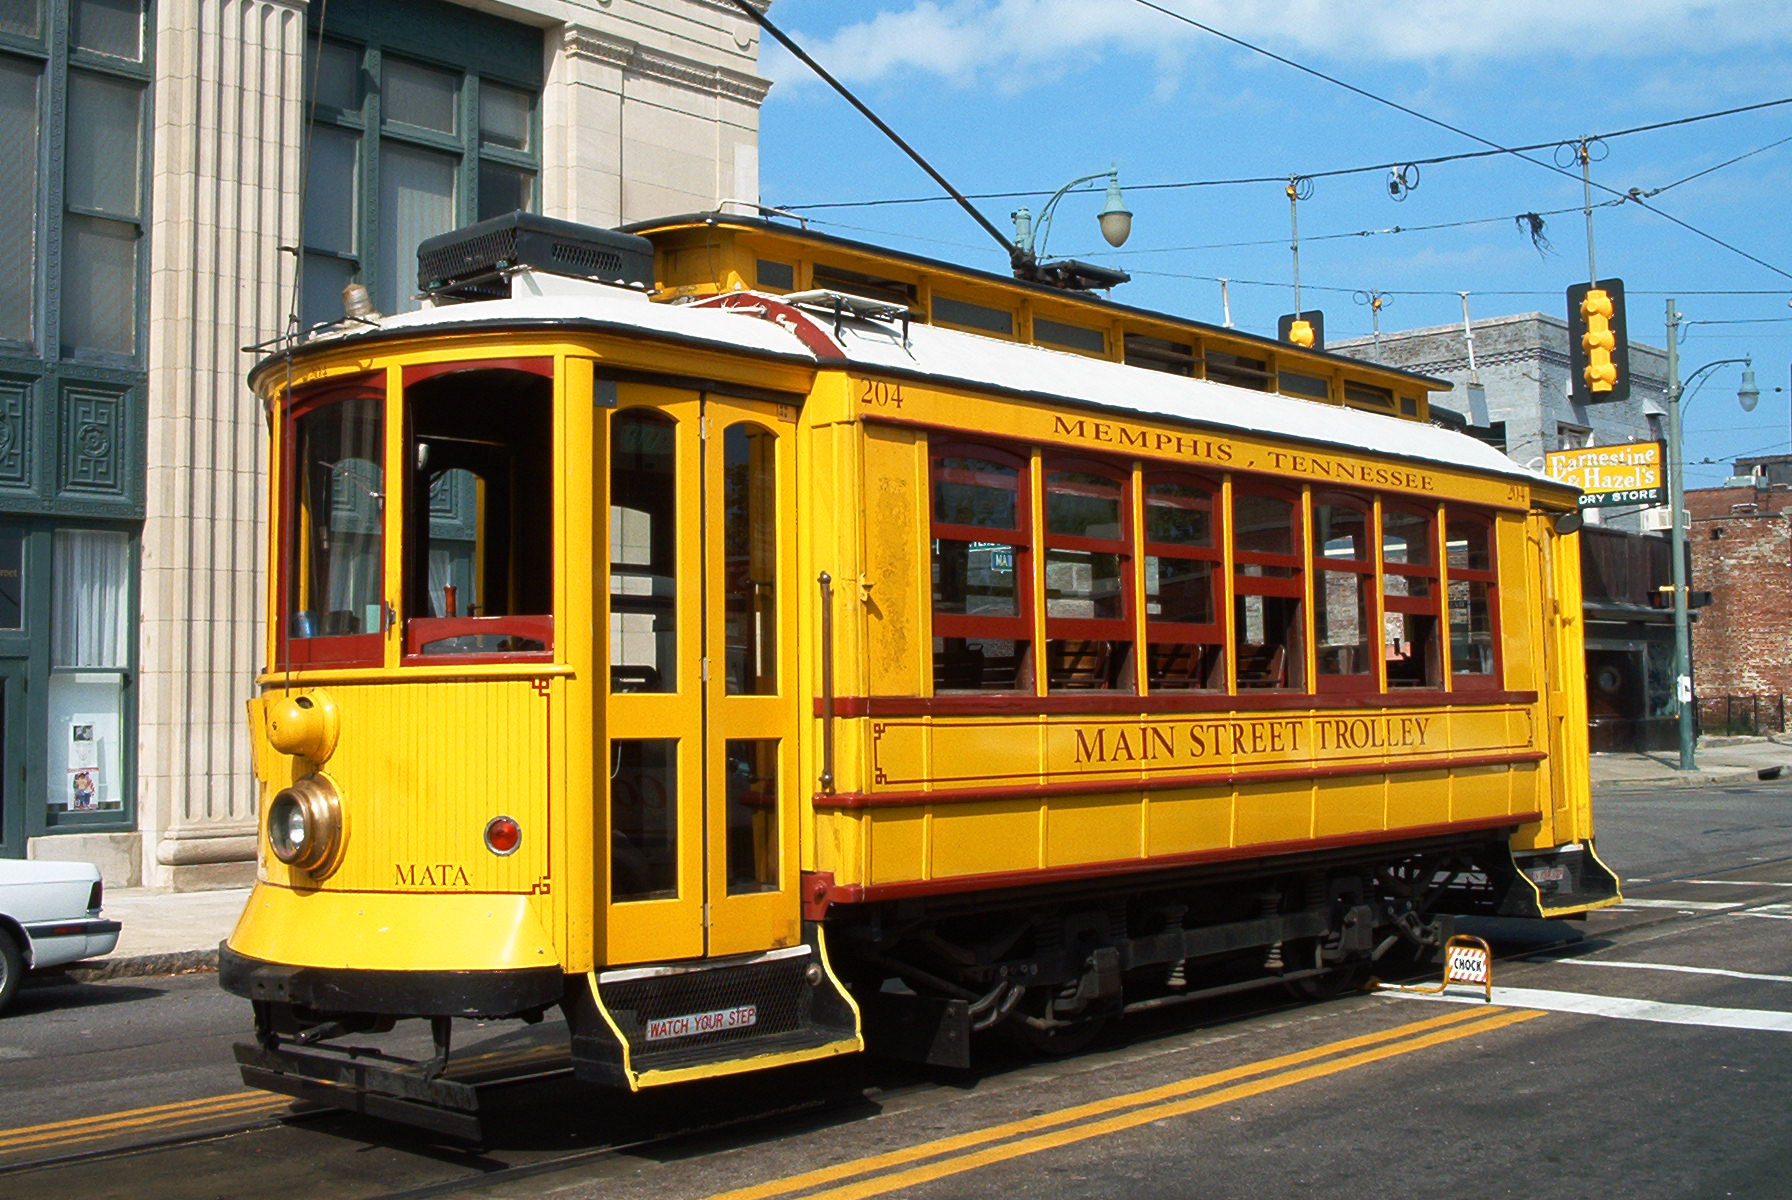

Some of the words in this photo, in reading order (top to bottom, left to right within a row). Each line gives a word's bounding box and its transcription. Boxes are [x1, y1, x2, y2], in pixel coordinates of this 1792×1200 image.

[860, 377, 903, 408] 204
[1267, 451, 1435, 491] TENNESSEE
[1551, 447, 1655, 481] Earnestine
[1583, 465, 1655, 489] Hazel's
[1611, 488, 1657, 502] STORE
[1074, 726, 1176, 763] MAIN
[1189, 720, 1303, 758] STREET
[1315, 717, 1431, 750] TROLLEY
[394, 864, 470, 886] MATA
[1454, 957, 1482, 972] CHOCK
[650, 1019, 689, 1038] WATCH
[694, 1012, 724, 1031] YOUR
[728, 1008, 756, 1026] STEP
